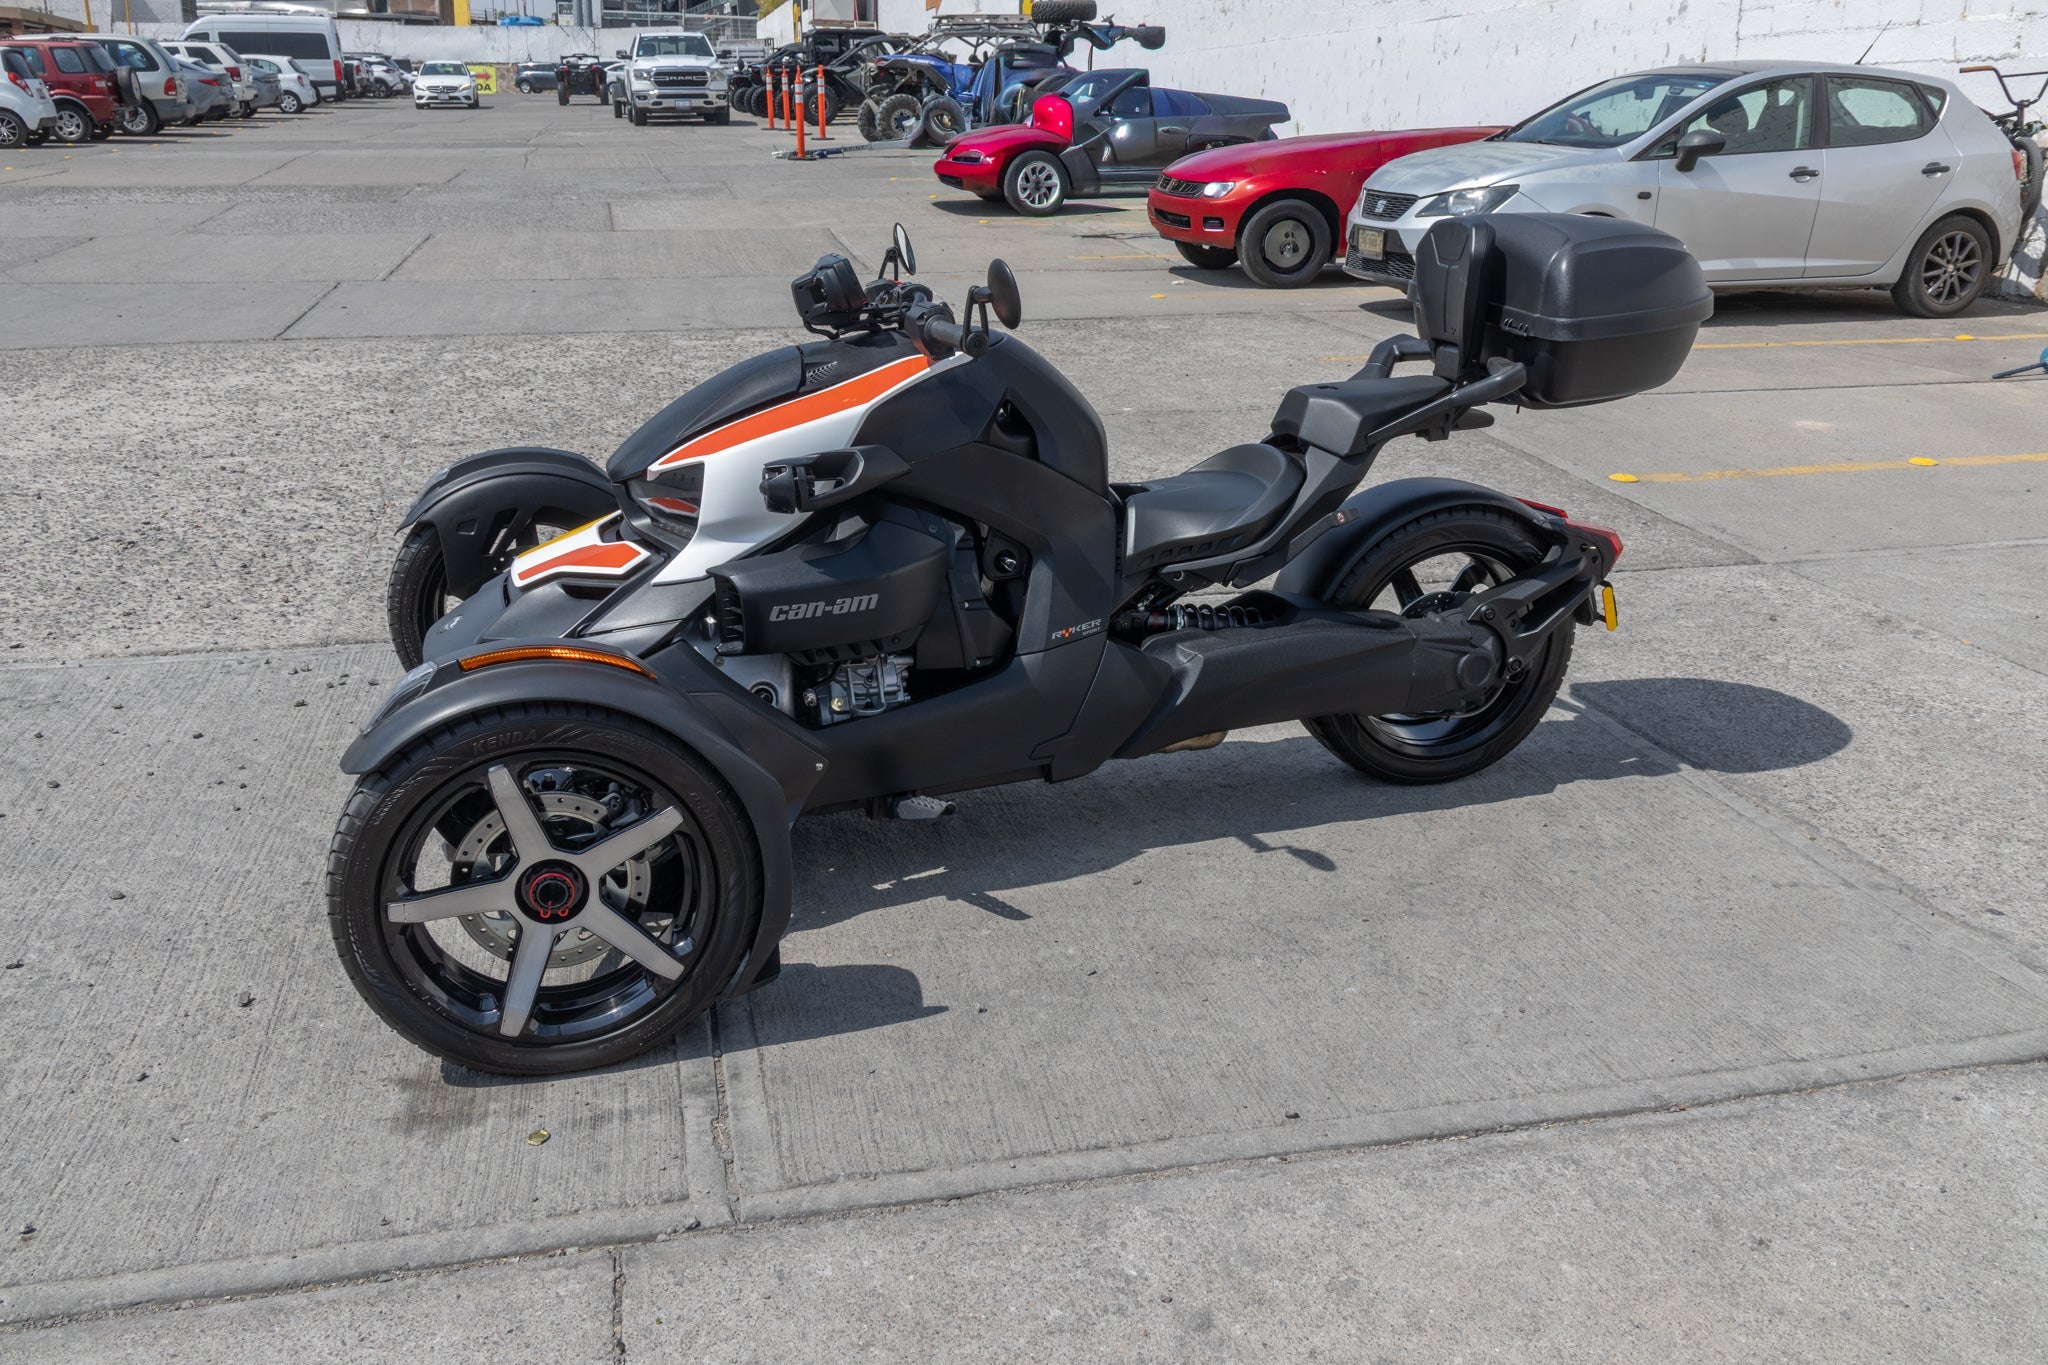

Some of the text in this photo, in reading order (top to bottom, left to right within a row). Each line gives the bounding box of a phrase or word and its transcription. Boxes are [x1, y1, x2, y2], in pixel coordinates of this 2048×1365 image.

[768, 593, 879, 622] can-am
[1051, 618, 1102, 640] RYKER
[1082, 626, 1101, 636] SPORT
[473, 729, 538, 751] KENDA
